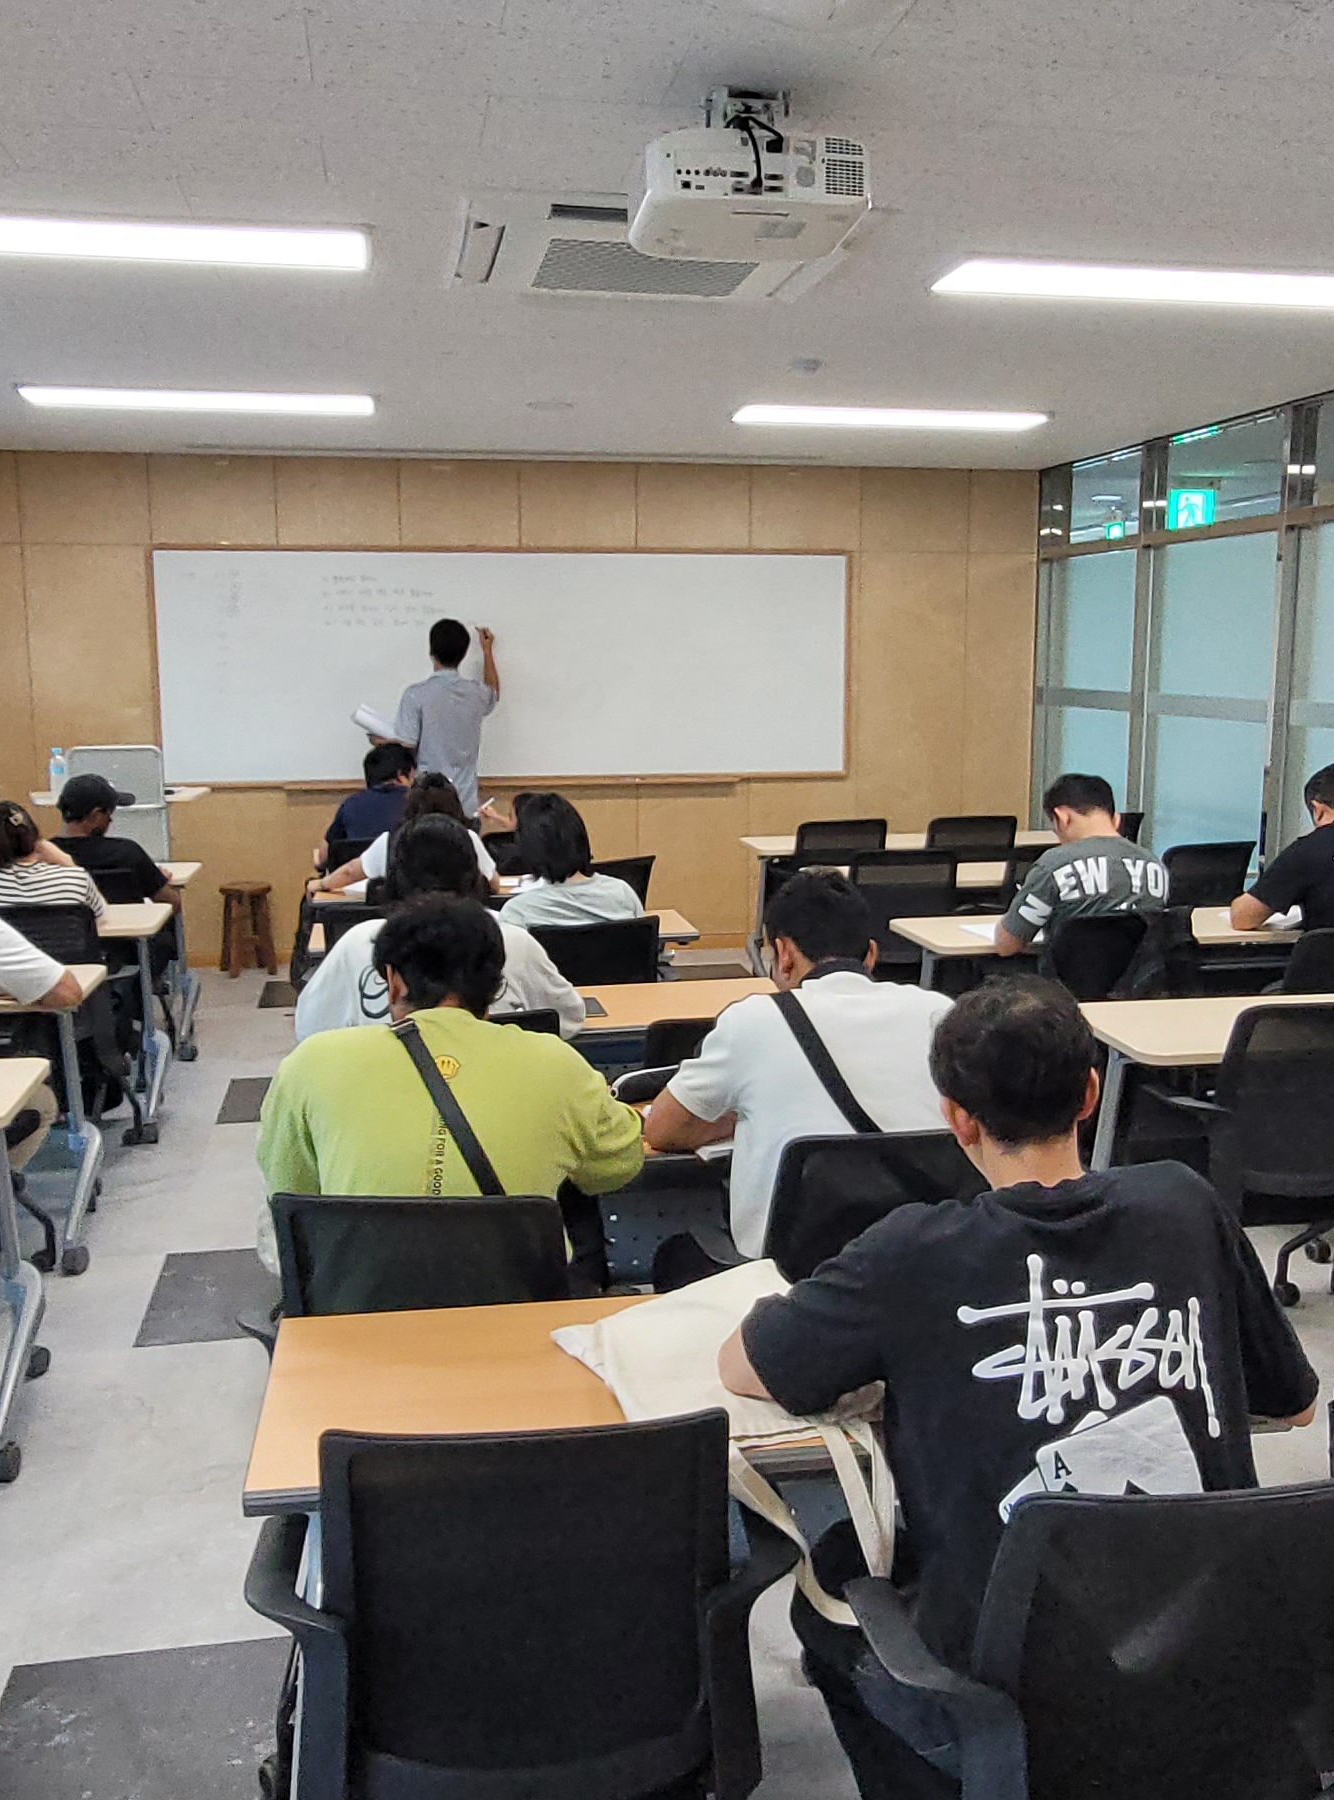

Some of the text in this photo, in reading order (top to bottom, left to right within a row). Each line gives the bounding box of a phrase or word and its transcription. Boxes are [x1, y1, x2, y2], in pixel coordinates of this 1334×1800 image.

[1122, 858, 1170, 906] YO
[436, 1138, 446, 1157] FOR
[432, 1168, 443, 1196] GOOD
[1054, 1450, 1072, 1480] A
